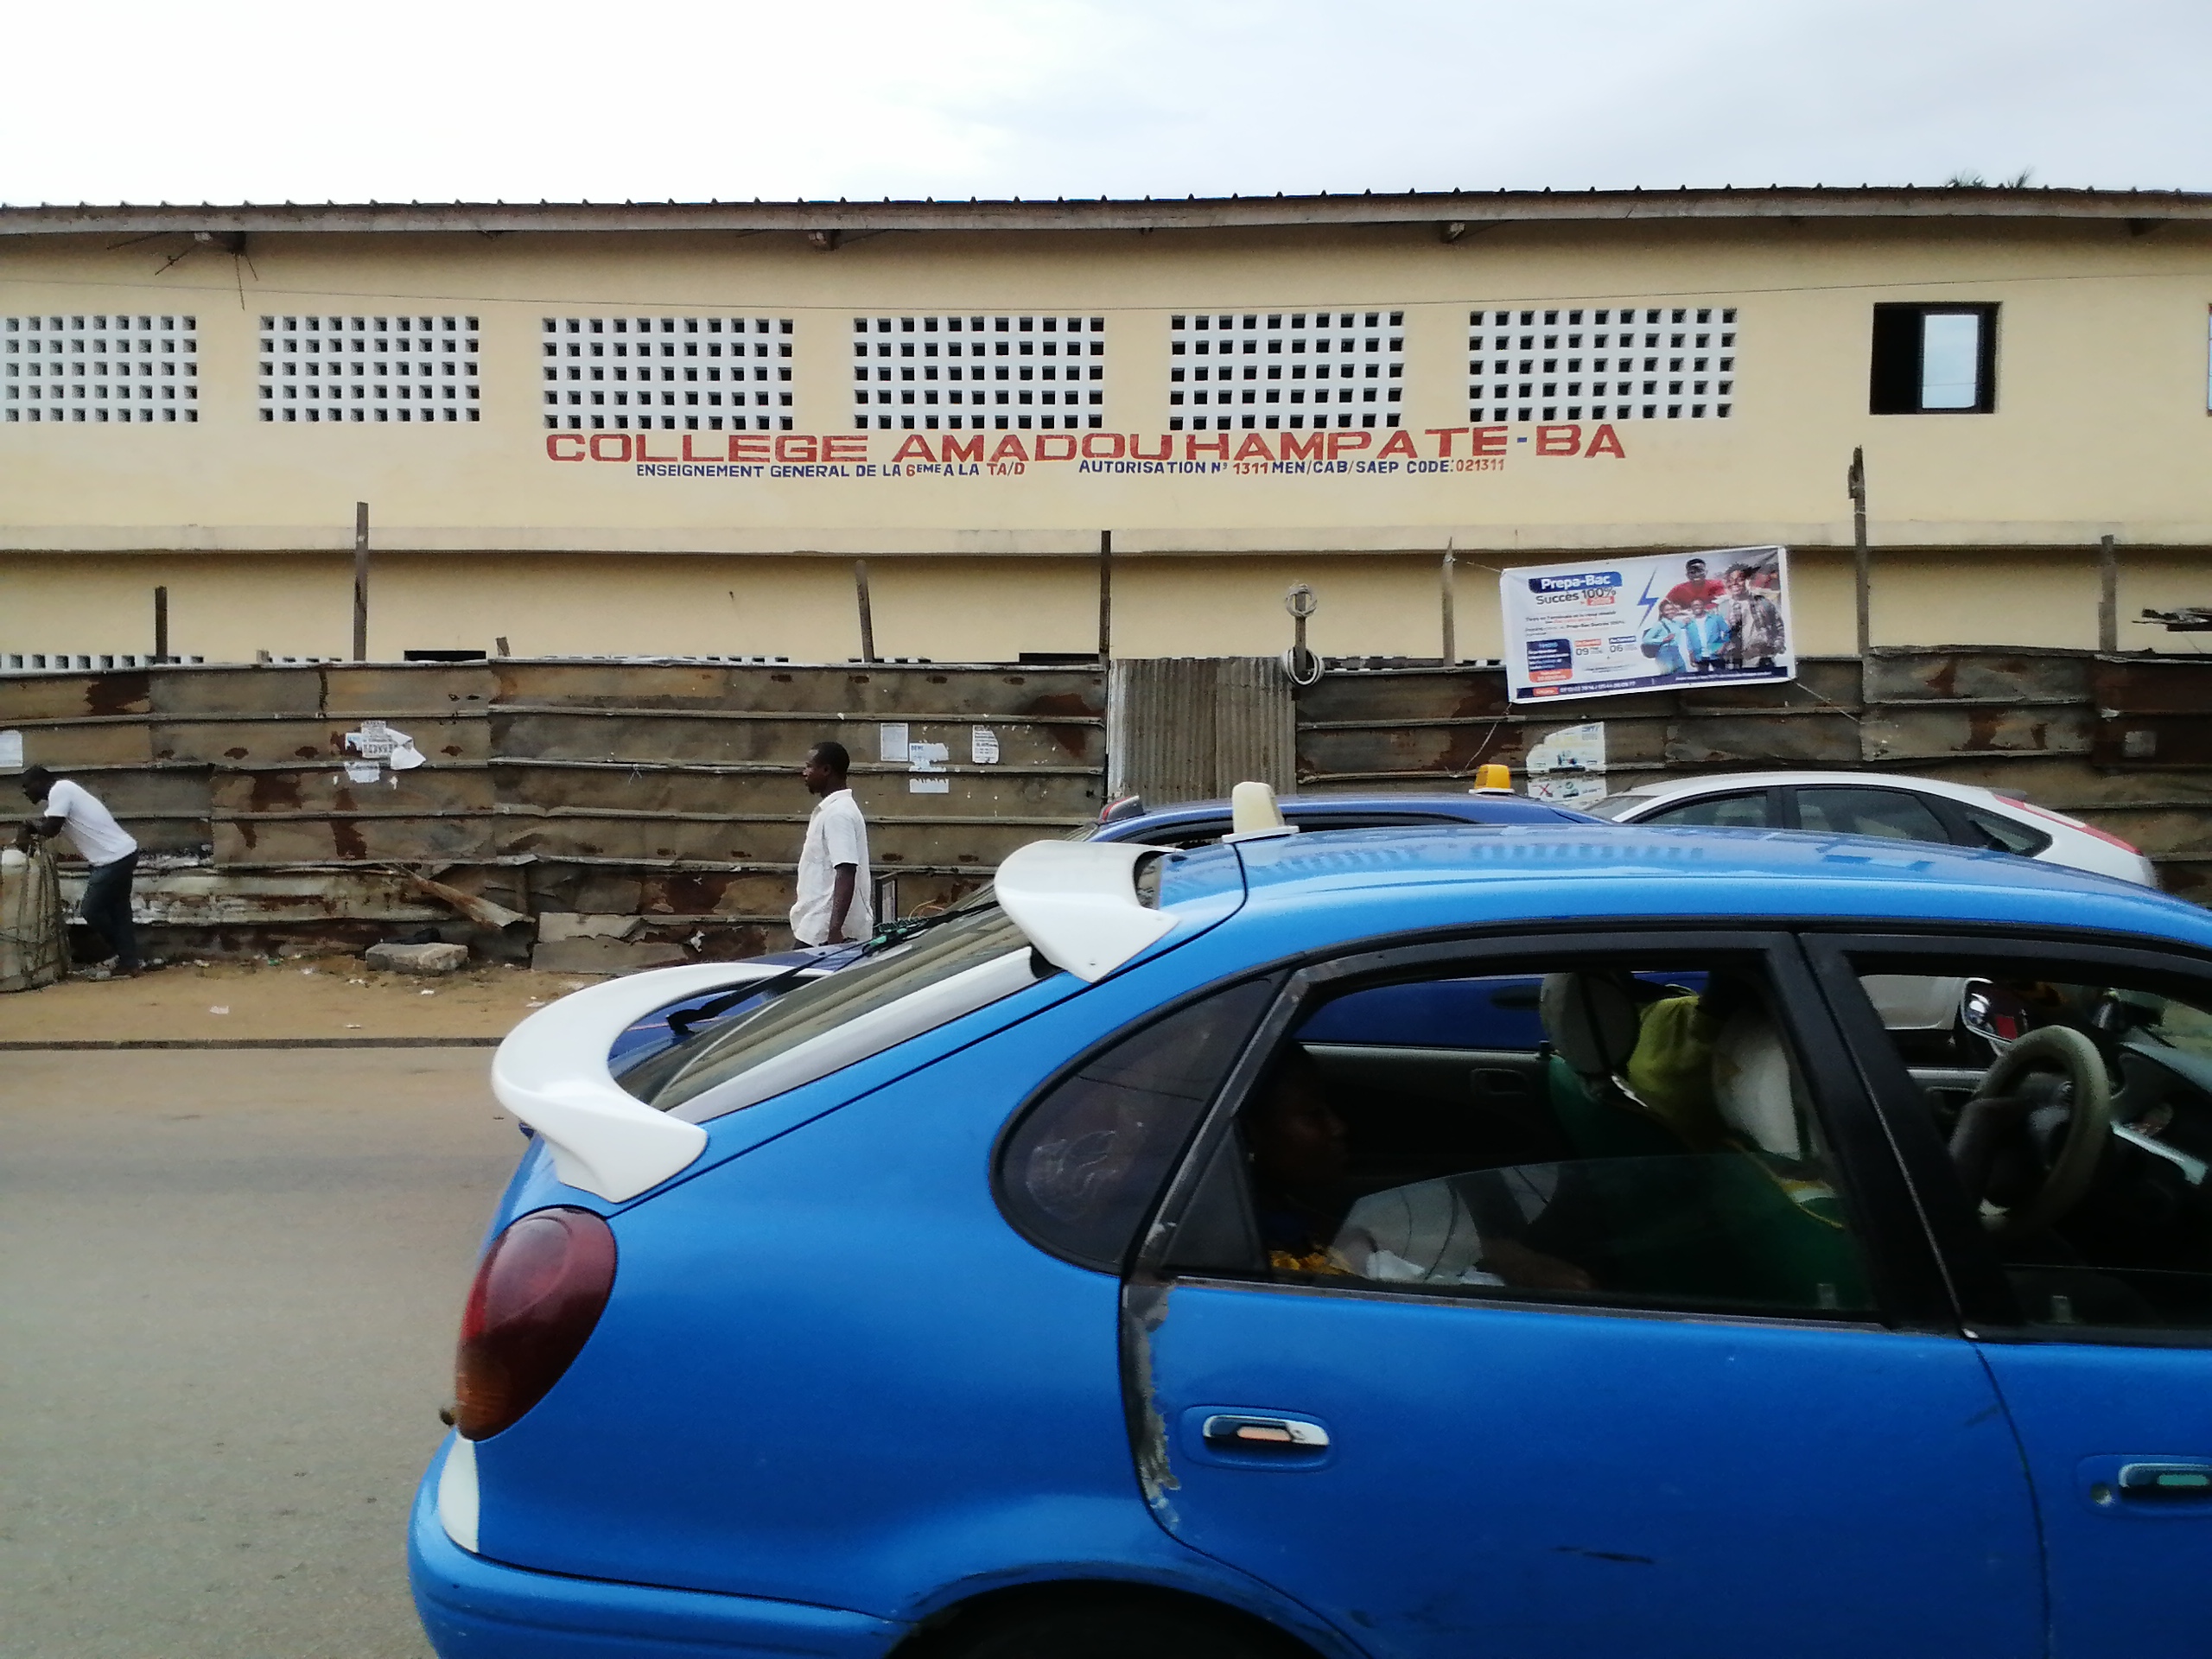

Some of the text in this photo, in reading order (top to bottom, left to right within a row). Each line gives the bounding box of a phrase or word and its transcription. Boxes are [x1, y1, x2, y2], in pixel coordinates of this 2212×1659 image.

[547, 434, 868, 462] COLLEGE
[892, 433, 1173, 462] AMADOU
[637, 464, 764, 477] ENSEIGNEMENT
[771, 465, 849, 477] GENERAL
[856, 465, 876, 476] DE
[883, 464, 901, 476] LA
[958, 463, 980, 476] LA
[1079, 460, 1205, 474] AUTORISATION
[1233, 462, 1268, 474] 1311
[1272, 461, 1400, 474] MEN/CAB/SAEP
[1541, 575, 1611, 591] Prepa-Bac
[1535, 591, 1580, 605] Succès
[1582, 587, 1617, 600] 100%
